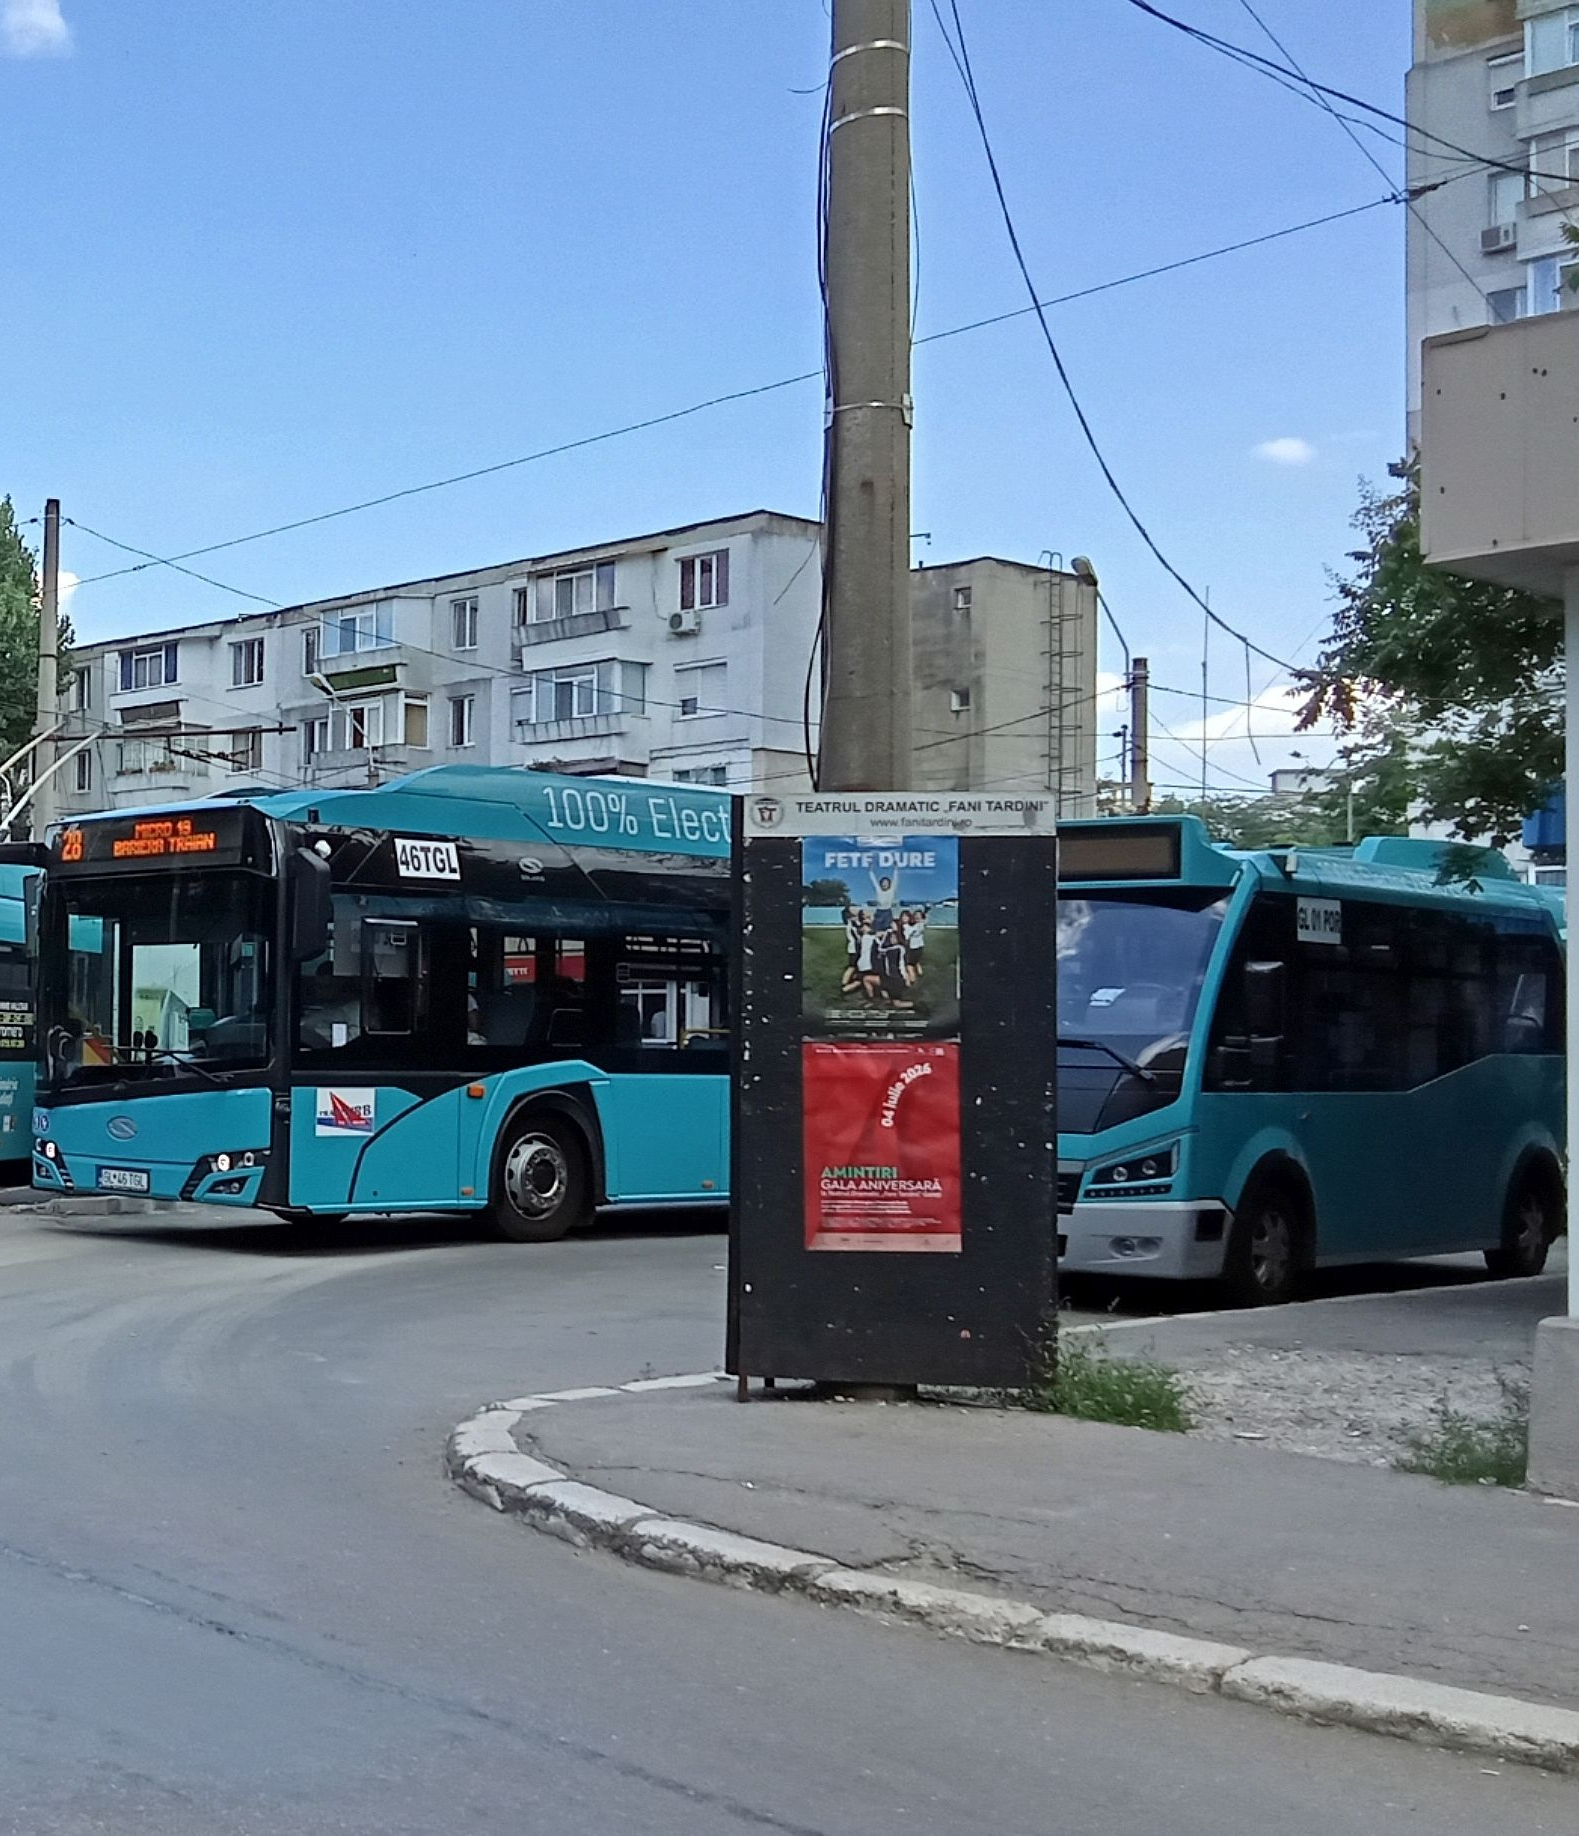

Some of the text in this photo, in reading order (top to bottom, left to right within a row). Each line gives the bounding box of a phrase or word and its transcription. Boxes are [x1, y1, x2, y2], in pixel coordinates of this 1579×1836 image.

[542, 786, 638, 835] 100%
[796, 801, 861, 813] TEATRUL
[865, 801, 940, 813] DRAMATIC
[135, 819, 192, 839] MICRO 19
[399, 844, 458, 874] 46TGL
[878, 852, 936, 868] DURE
[881, 1110, 895, 1127] 04
[821, 1166, 898, 1179] AMINTIRI
[821, 1177, 943, 1191] GALA ANIVERSARĂ
